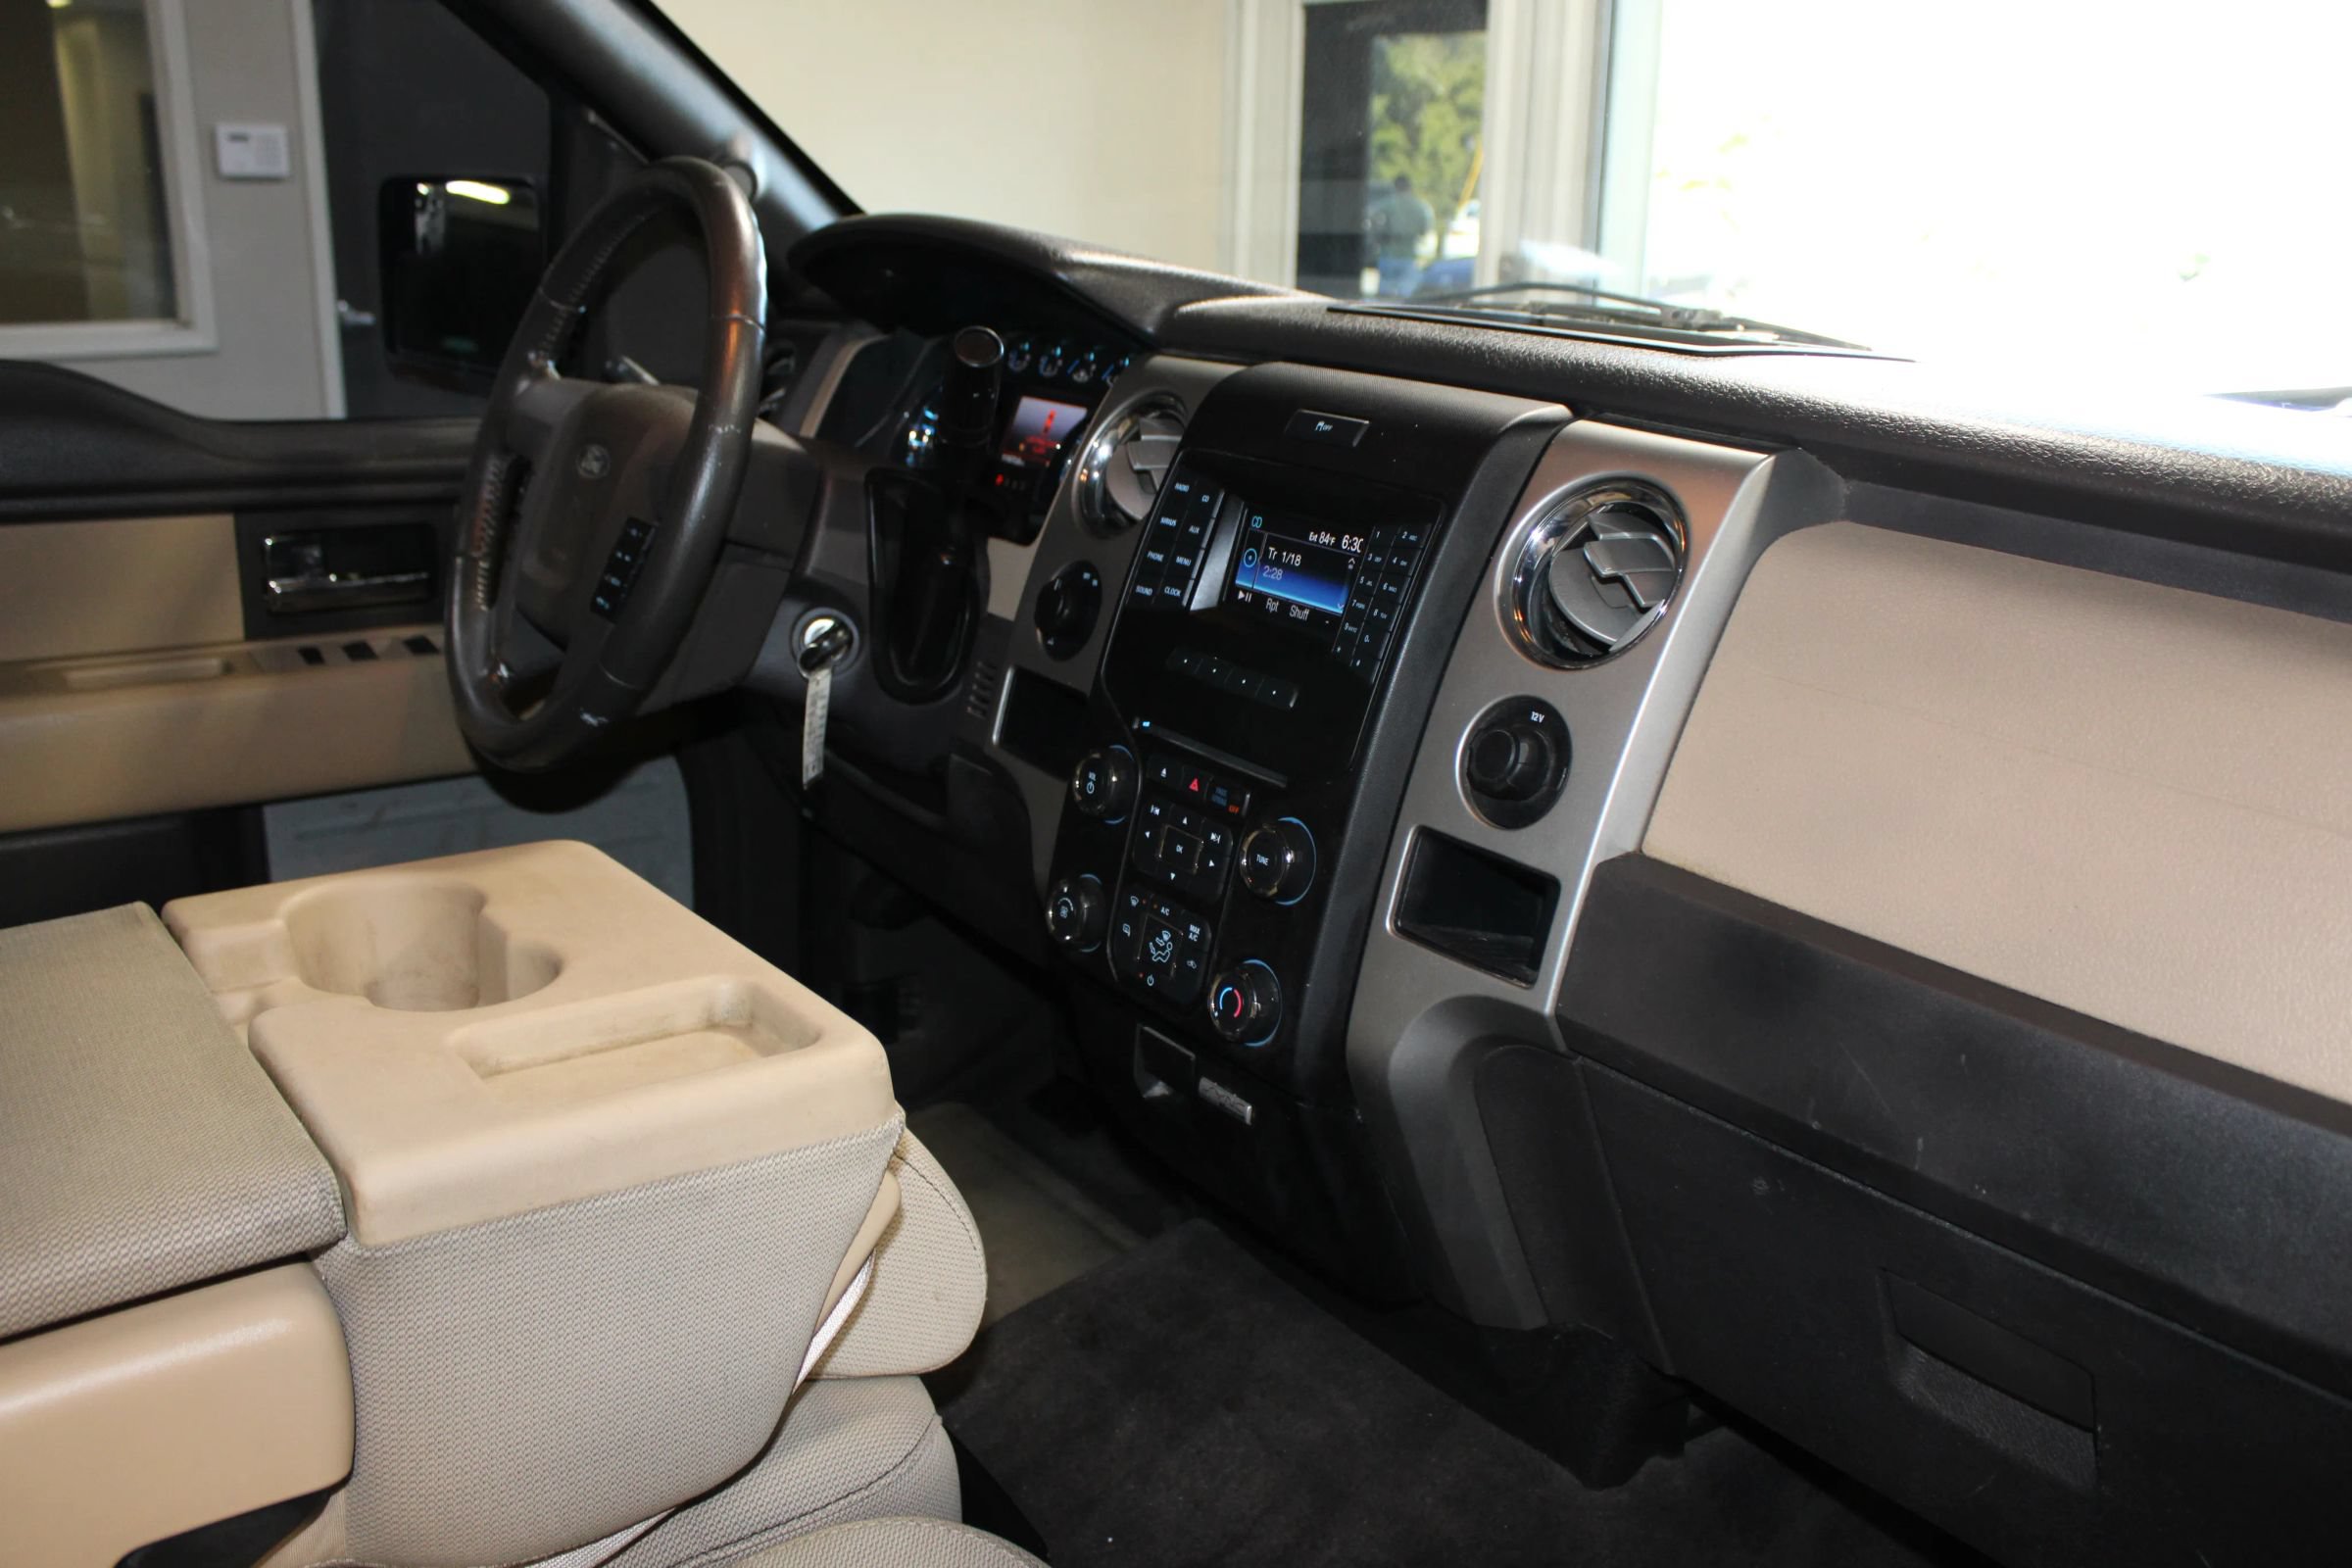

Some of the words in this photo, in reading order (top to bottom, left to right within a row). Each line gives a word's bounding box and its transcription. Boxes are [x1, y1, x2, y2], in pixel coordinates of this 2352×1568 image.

[1251, 515, 1262, 528] CD
[1189, 525, 1200, 534] AUX
[1176, 556, 1192, 566] MENU
[1269, 547, 1278, 559] Tr
[1282, 551, 1301, 566] 1/18
[1262, 565, 1284, 580] 2:28
[1164, 586, 1181, 597] CLOCK
[1266, 598, 1280, 612] Rpt
[1290, 605, 1310, 621] Shuff
[1530, 710, 1545, 723] 12V
[1256, 854, 1269, 866] TUNE
[1160, 906, 1170, 916] A/C
[1189, 924, 1200, 935] MAX
[1188, 933, 1199, 942] A/C
